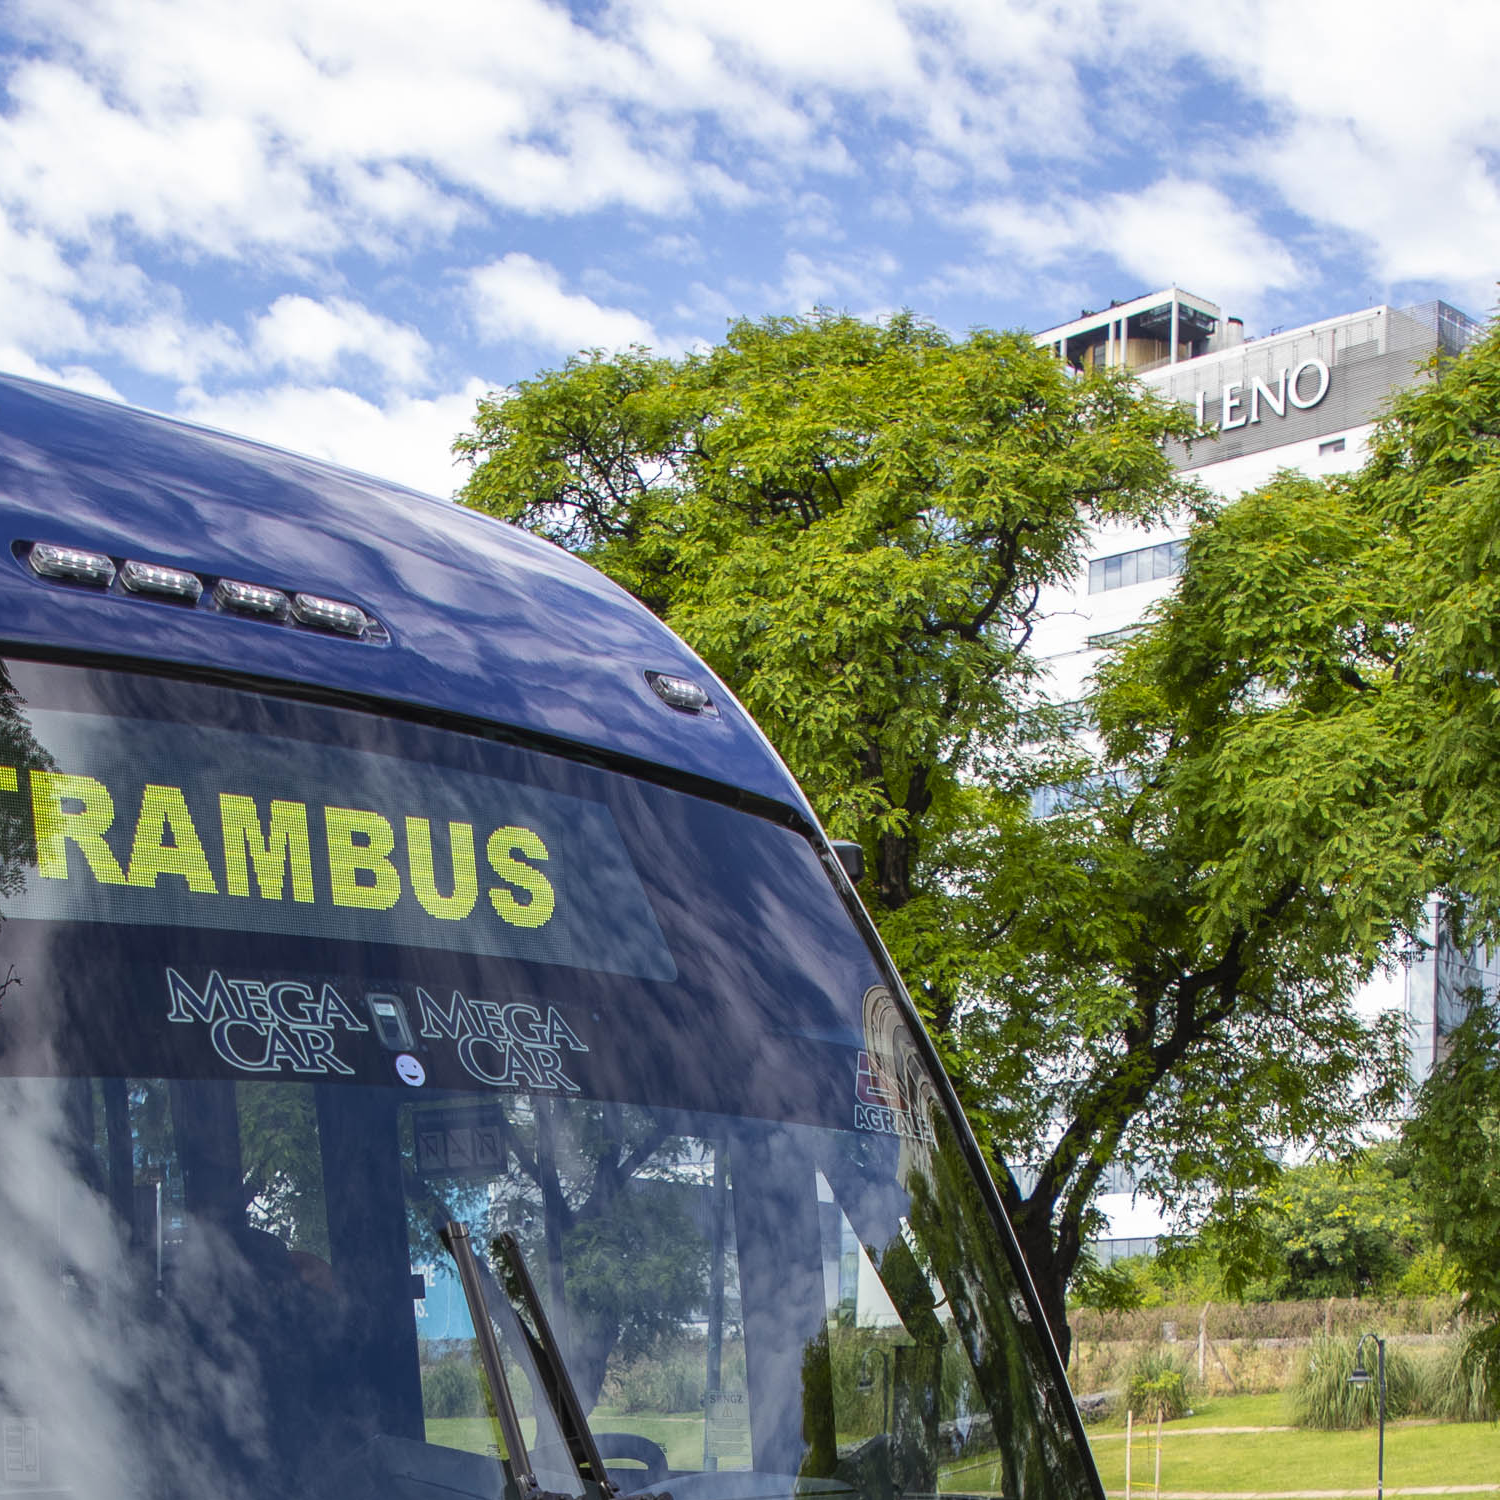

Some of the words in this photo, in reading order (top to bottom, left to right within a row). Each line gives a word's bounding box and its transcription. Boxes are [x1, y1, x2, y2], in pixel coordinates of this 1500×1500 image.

[166, 967, 369, 1031] MEGA
[416, 986, 590, 1052] MEGA
[211, 1016, 356, 1075] CAR
[458, 1034, 581, 1092] CAR
